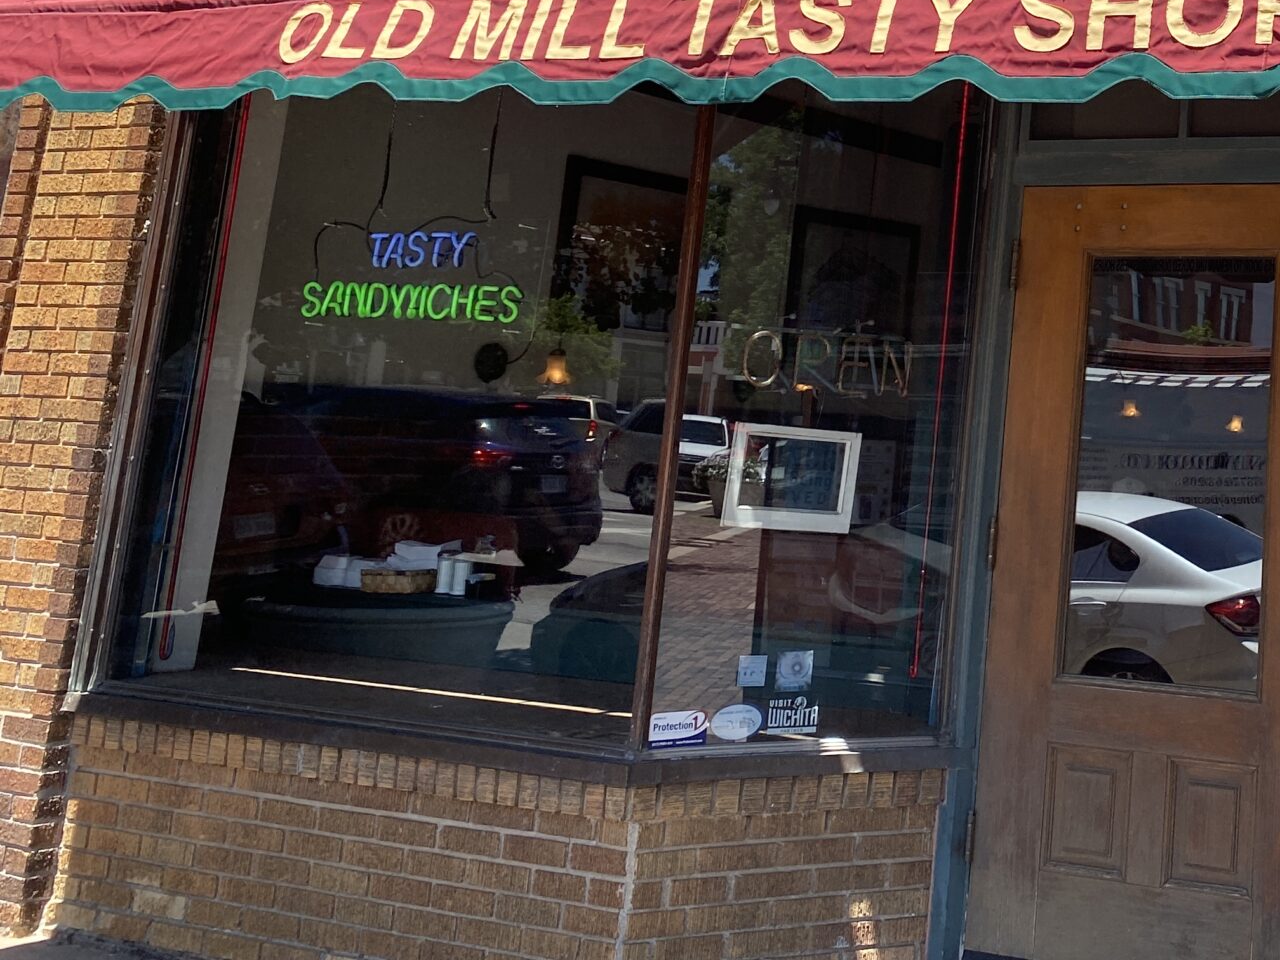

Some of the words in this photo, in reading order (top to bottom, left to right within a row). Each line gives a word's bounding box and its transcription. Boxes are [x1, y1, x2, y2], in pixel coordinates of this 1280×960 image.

[370, 231, 477, 269] TASTY
[301, 280, 525, 323] SANDWICHES
[743, 330, 913, 398] OPEN
[767, 704, 819, 727] WICHITA
[769, 699, 792, 707] VISIT
